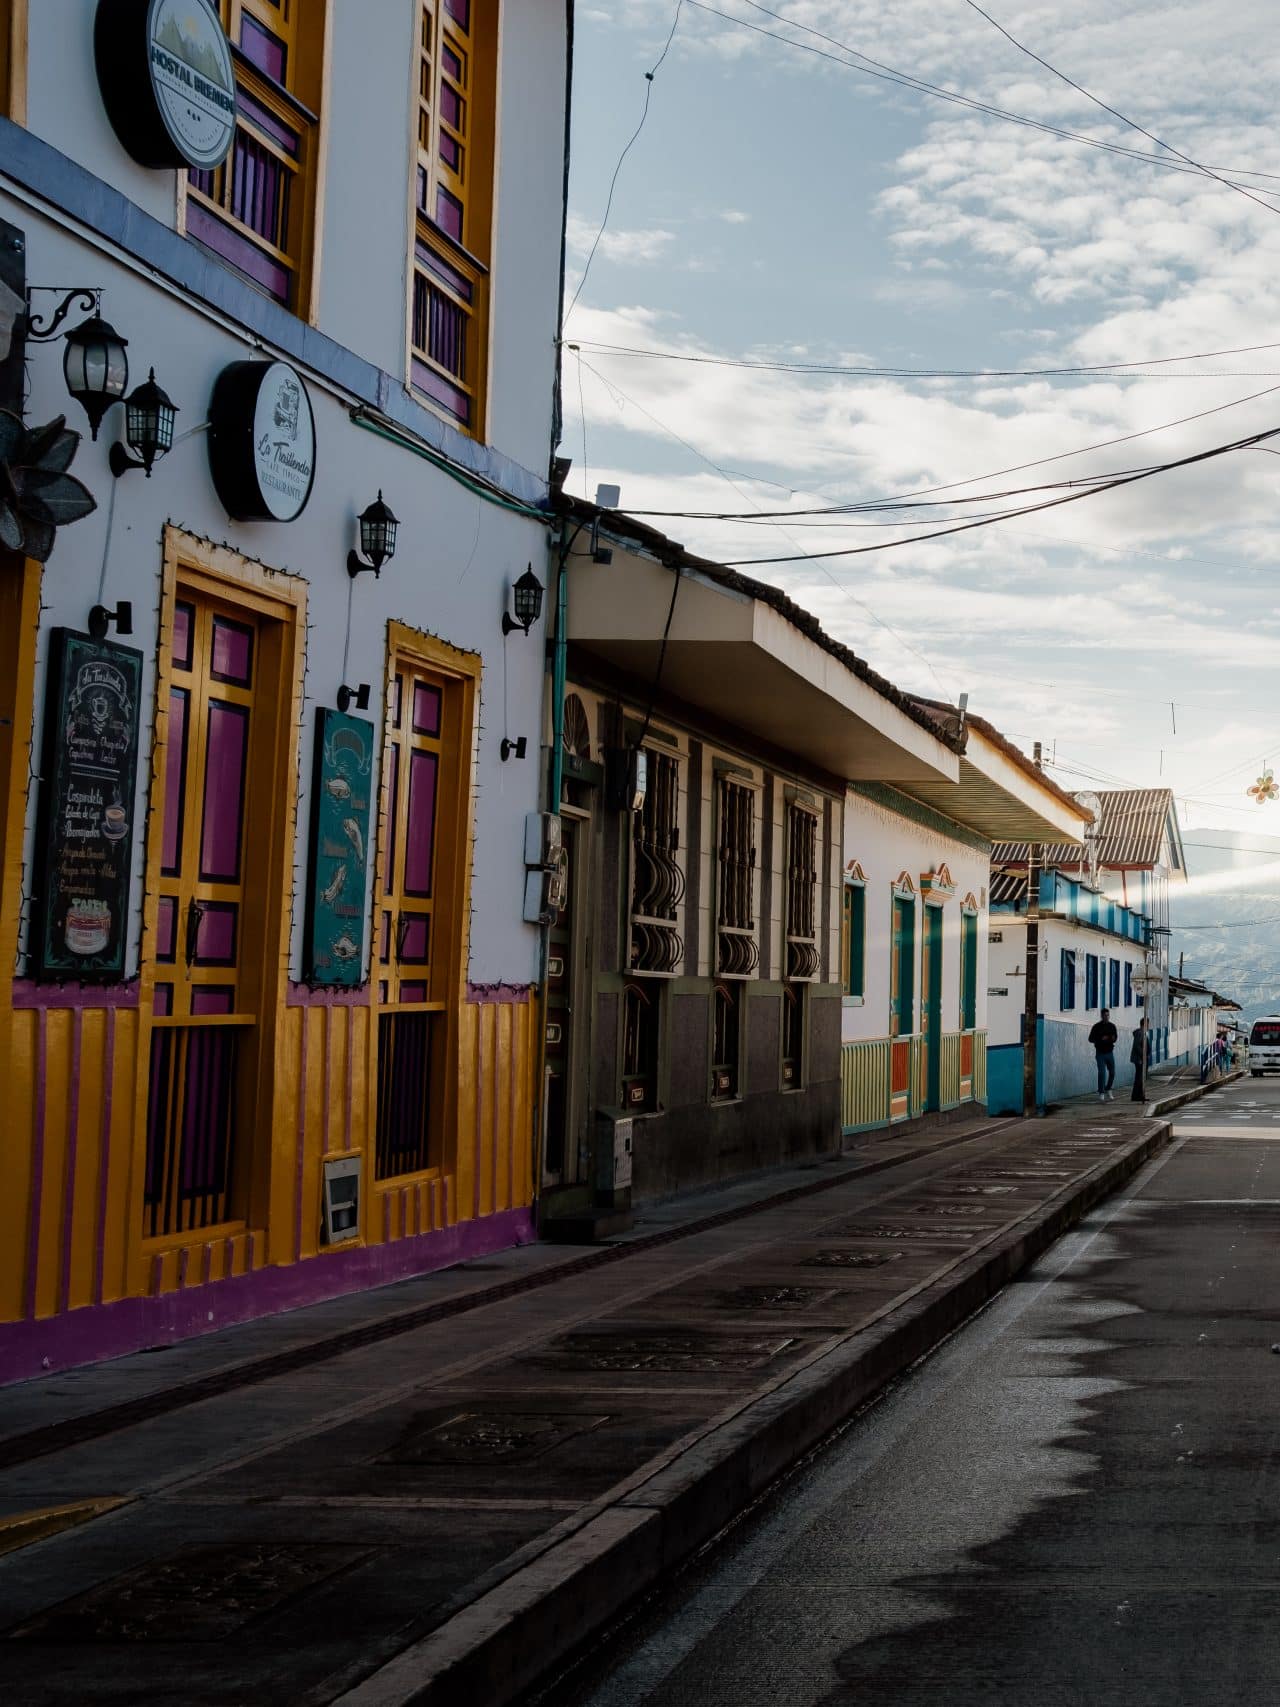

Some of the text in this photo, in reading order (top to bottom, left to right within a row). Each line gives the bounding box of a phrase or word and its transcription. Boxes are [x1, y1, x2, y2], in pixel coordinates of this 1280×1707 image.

[152, 46, 193, 87] HOSTAL
[194, 75, 233, 114] BREMEN
[258, 432, 271, 456] La
[261, 471, 303, 500] RESTAURANTE
